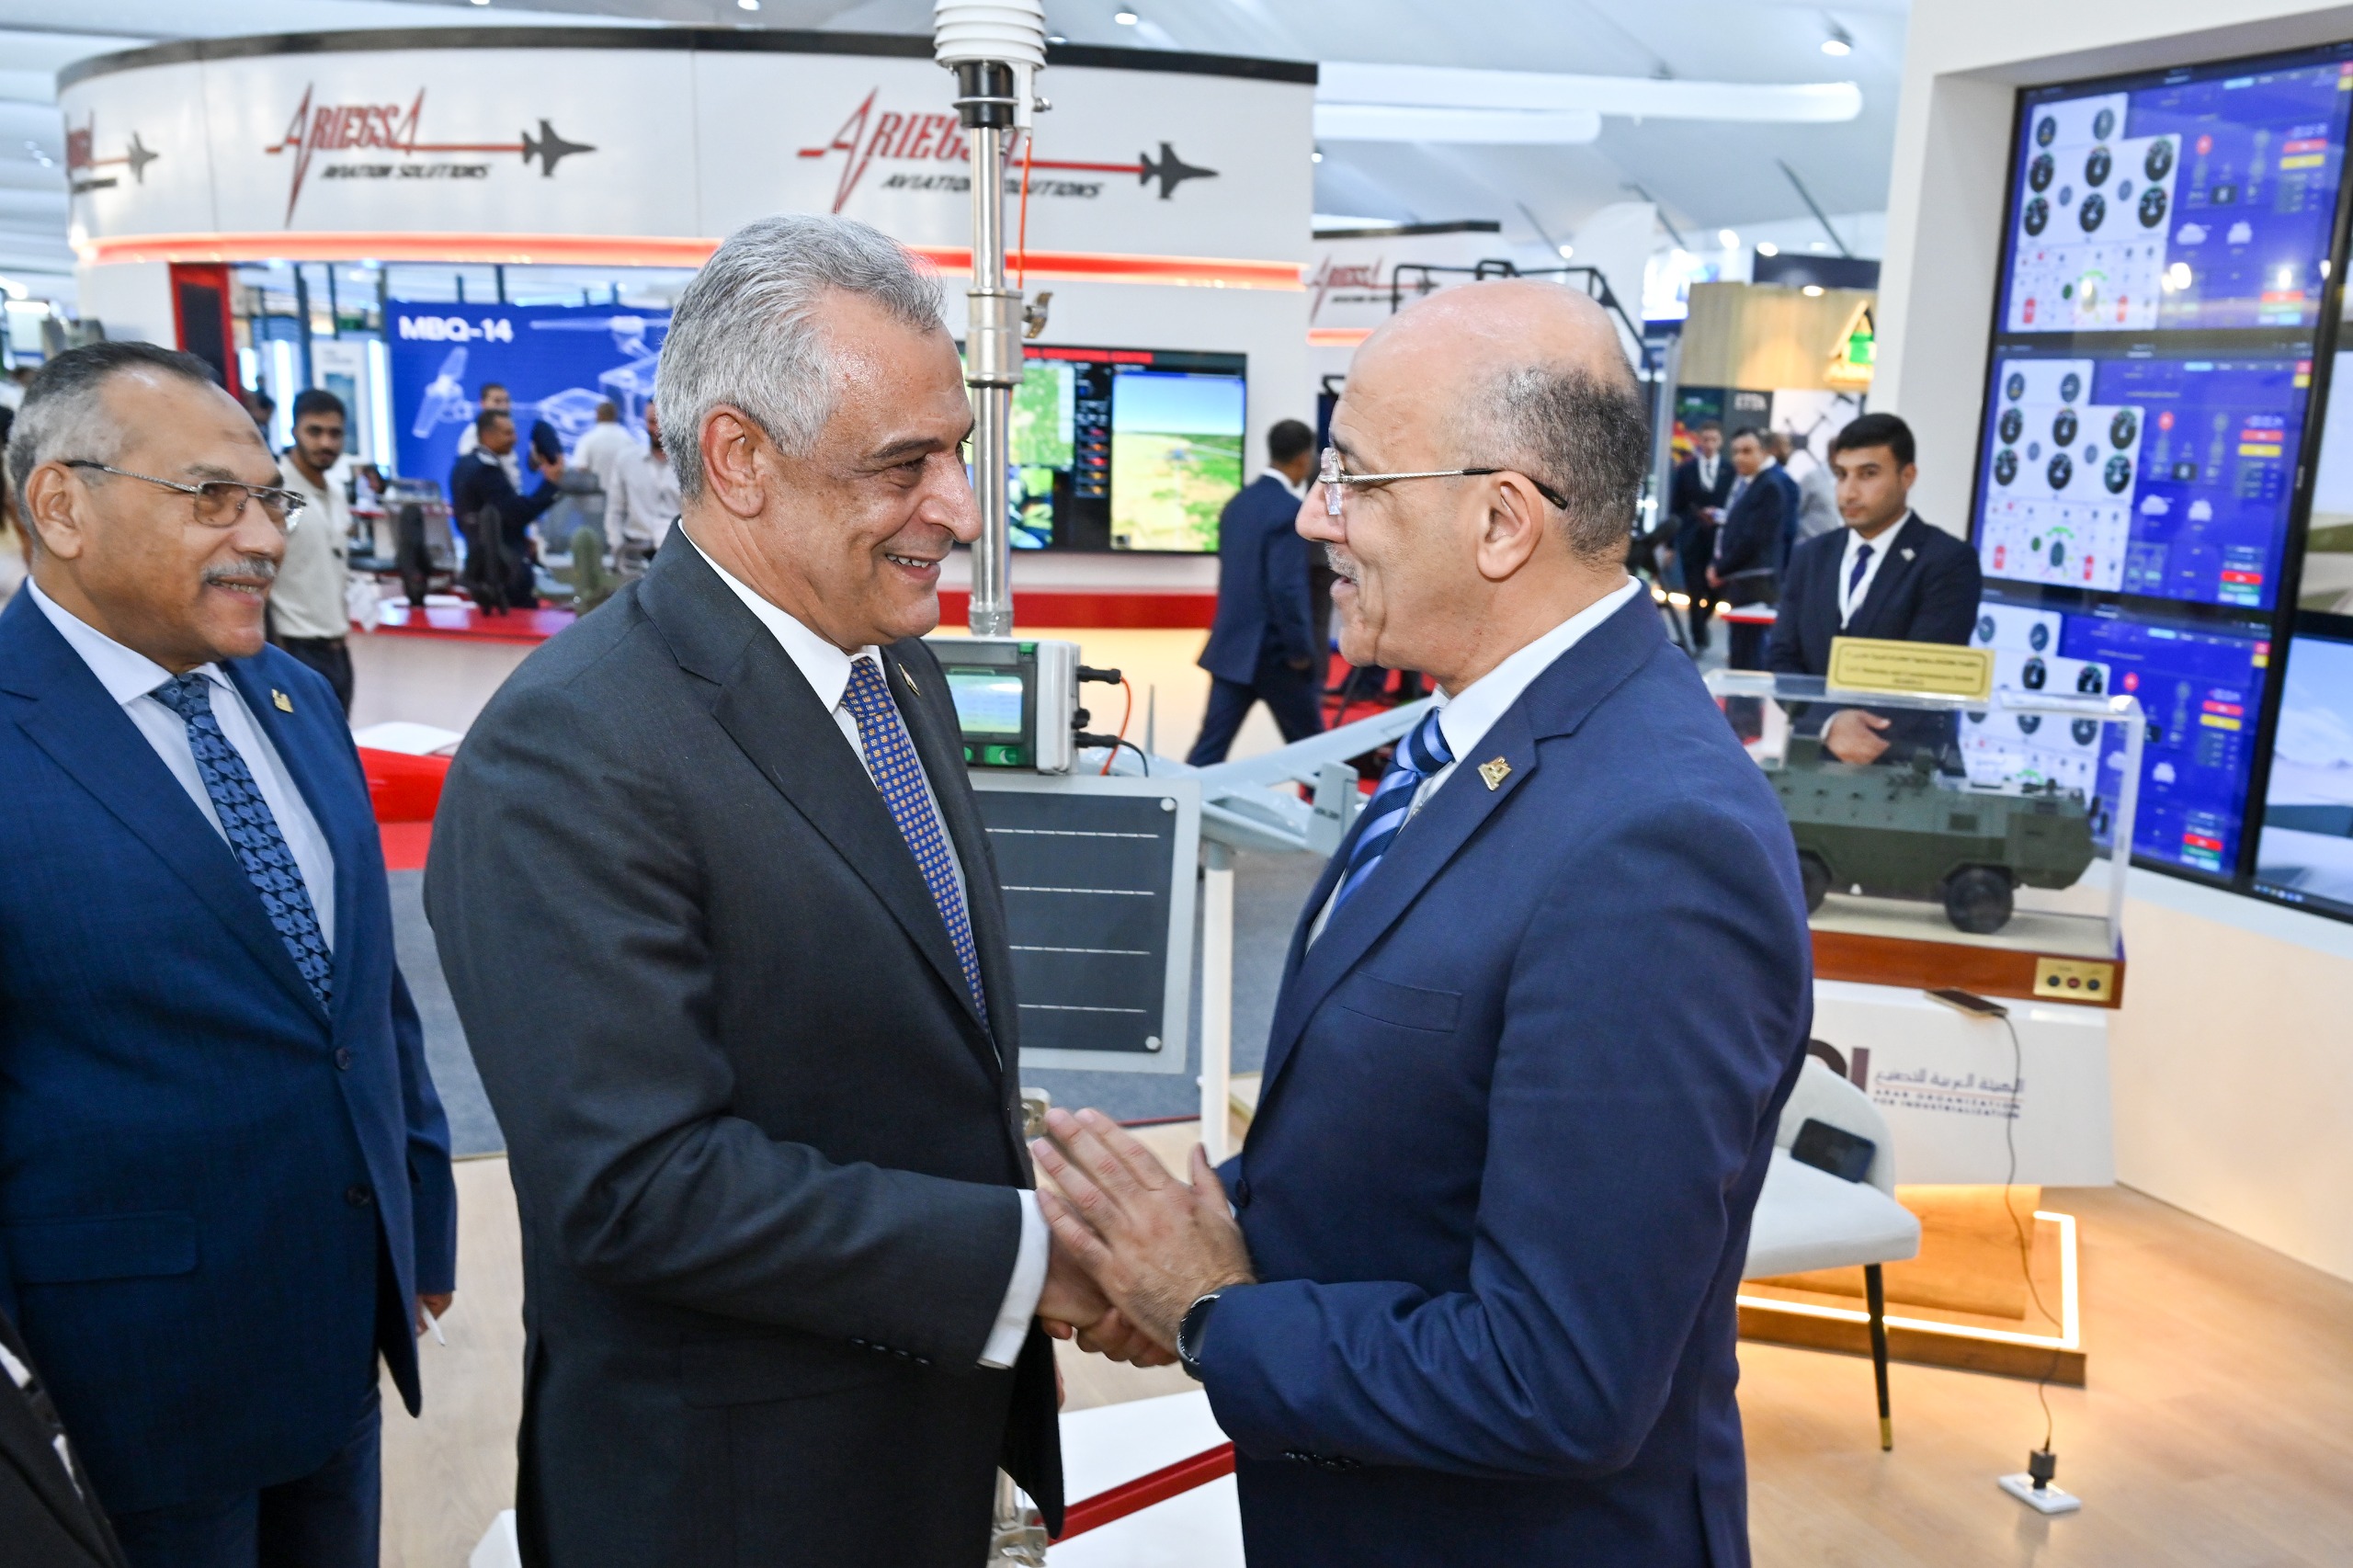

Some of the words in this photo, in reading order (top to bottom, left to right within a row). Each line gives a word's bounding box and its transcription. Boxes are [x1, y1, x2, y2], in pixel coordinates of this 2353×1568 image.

[881, 173, 972, 192] AVIATIO
[1004, 178, 1101, 198] OLUTIONS
[398, 315, 515, 343] MBQ-14
